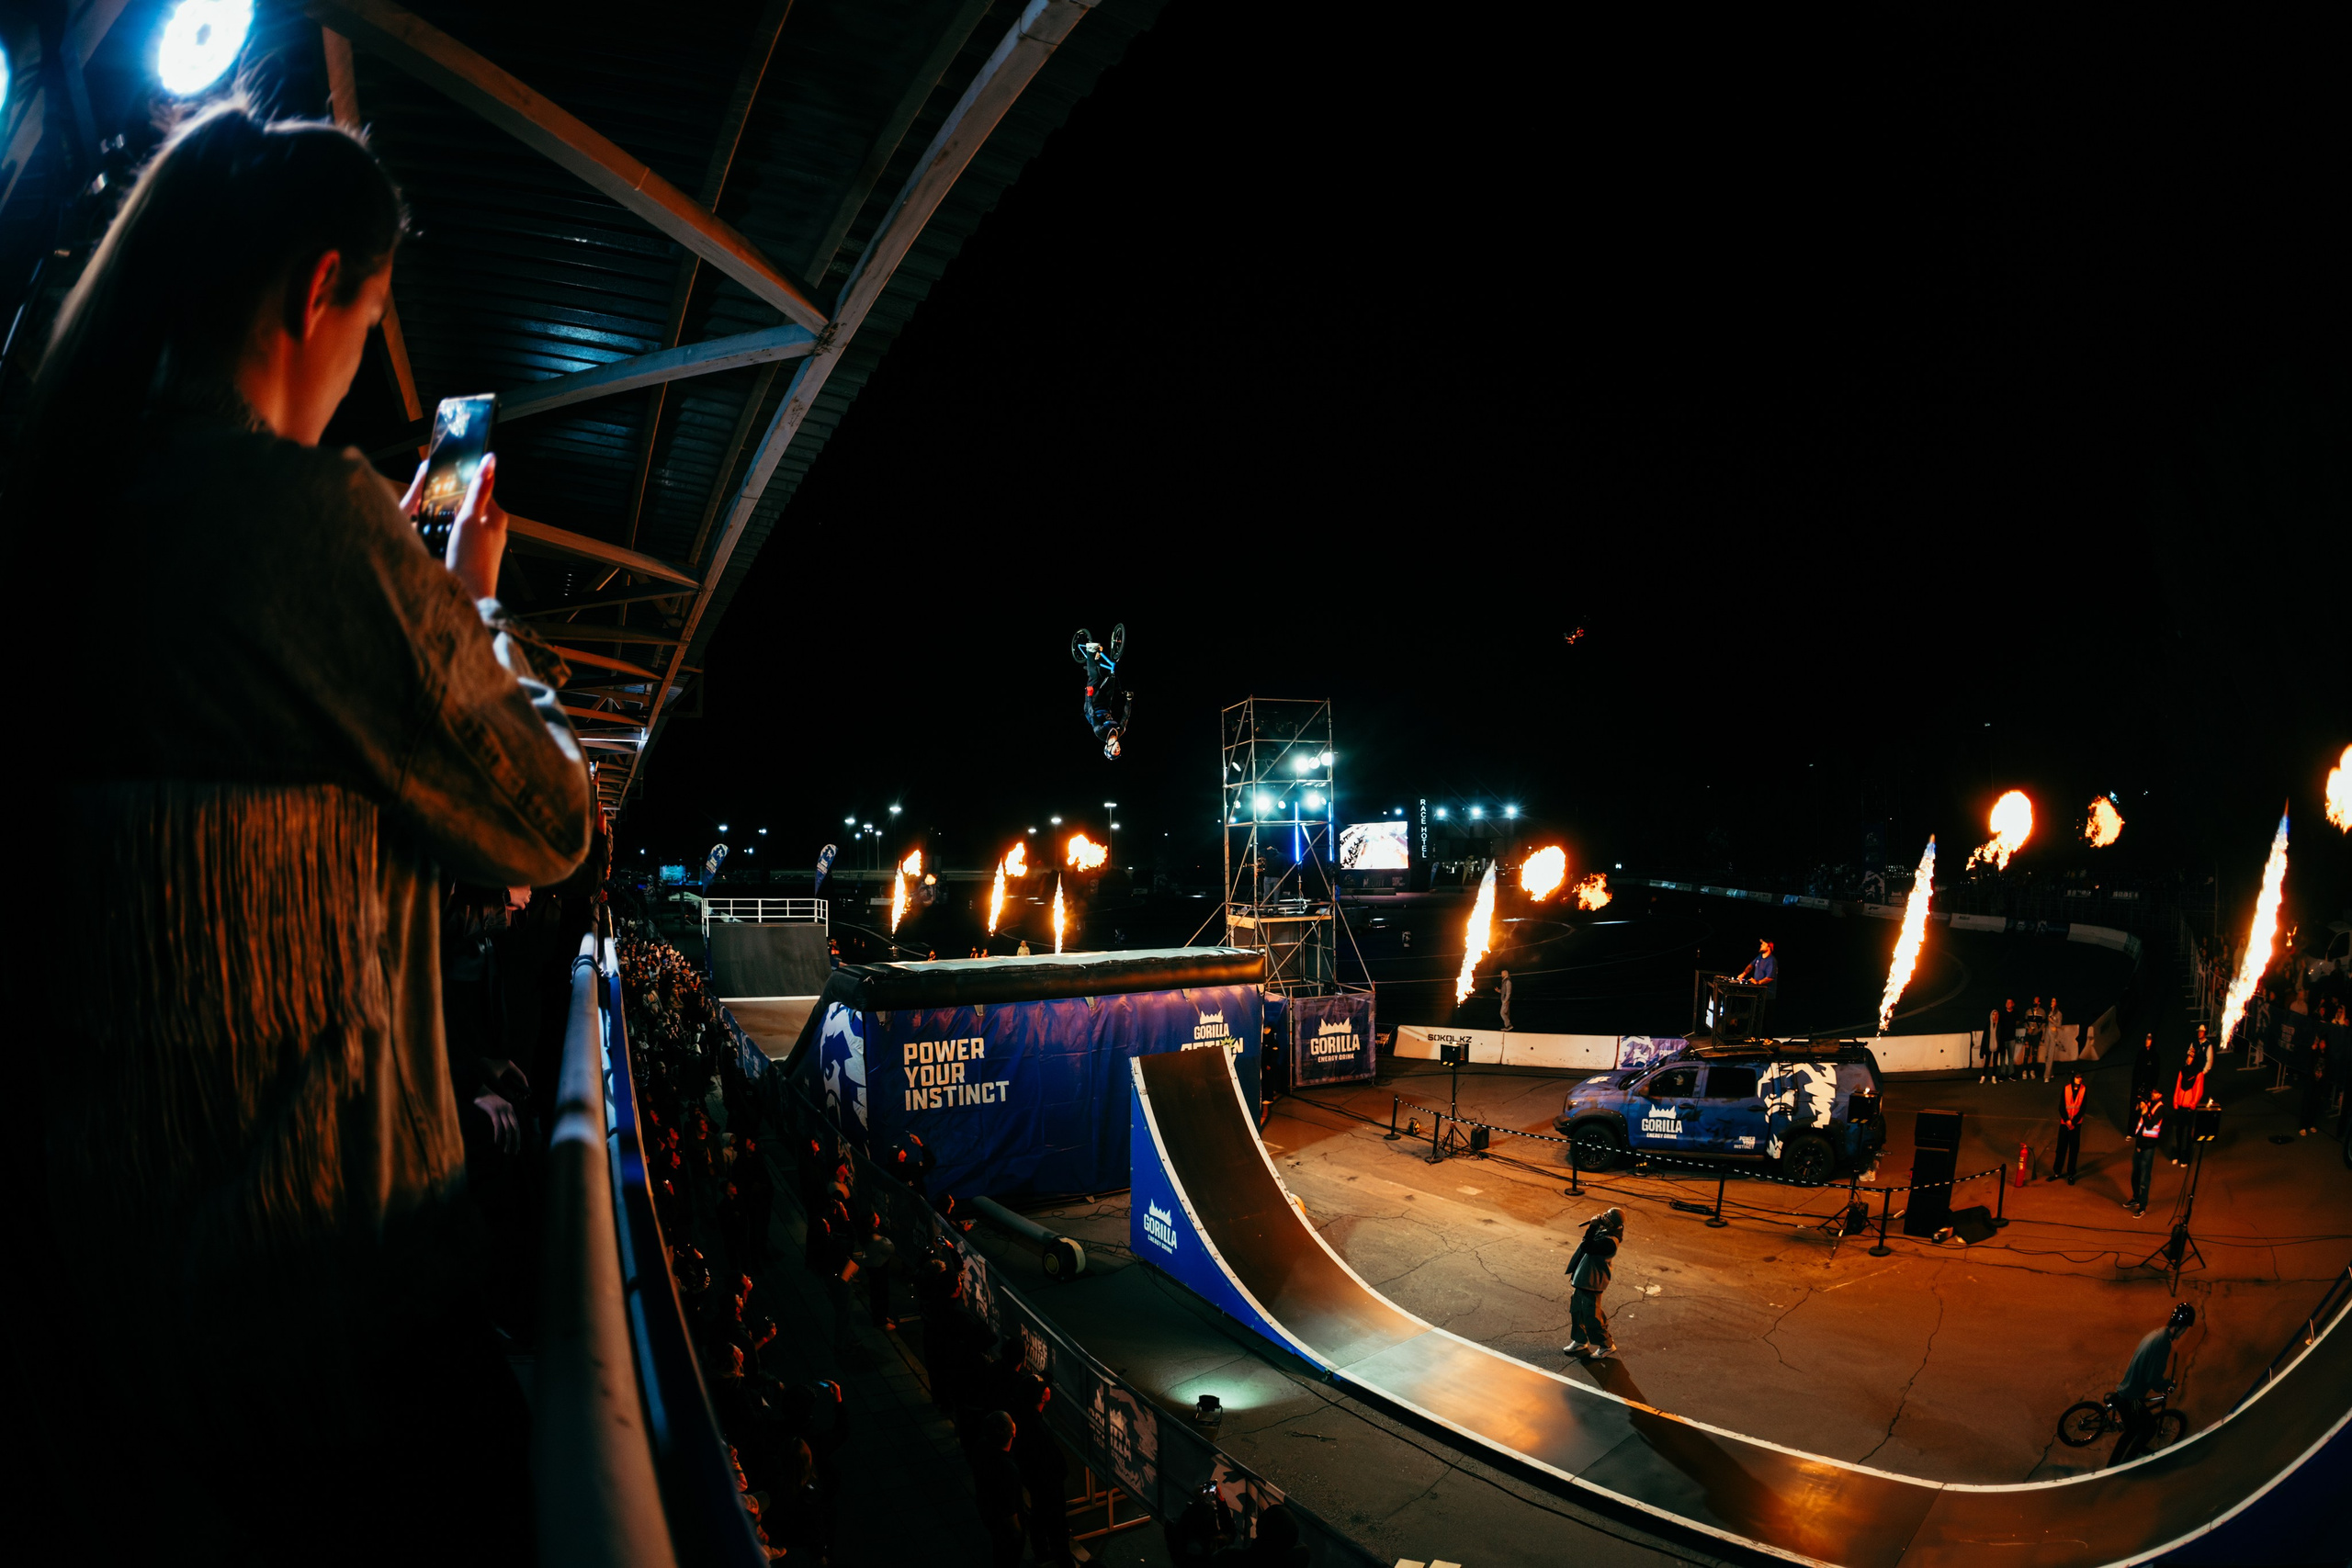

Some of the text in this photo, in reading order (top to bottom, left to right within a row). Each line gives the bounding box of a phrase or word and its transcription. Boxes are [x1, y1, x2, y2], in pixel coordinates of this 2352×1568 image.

[1193, 1022, 1230, 1040] GORILLA
[903, 1037, 985, 1066] POWER
[1310, 1033, 1360, 1055] GORILLA
[1317, 1053, 1354, 1063] ENERGY DRINK
[903, 1062, 966, 1089] YOUR
[905, 1080, 1010, 1111] INSTINCT
[1641, 1118, 1683, 1134] GORILLA
[1143, 1213, 1178, 1250] GORILLA
